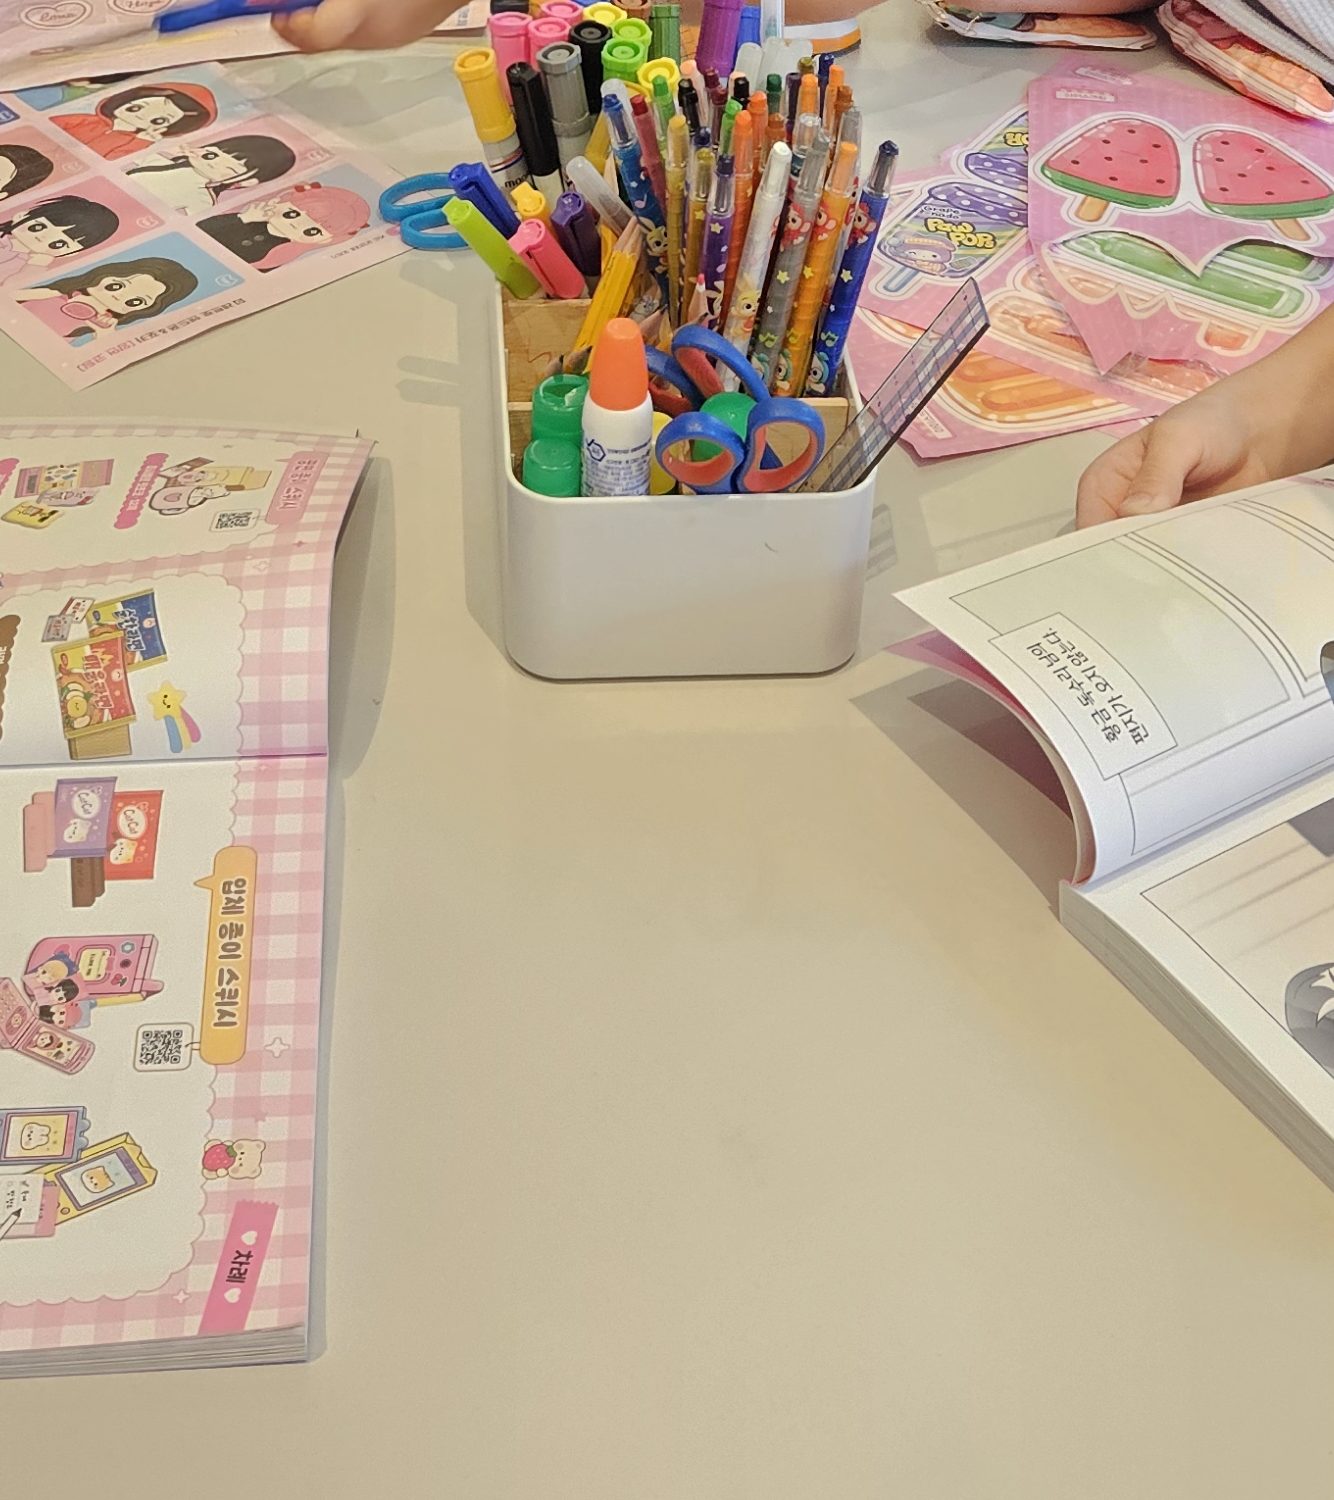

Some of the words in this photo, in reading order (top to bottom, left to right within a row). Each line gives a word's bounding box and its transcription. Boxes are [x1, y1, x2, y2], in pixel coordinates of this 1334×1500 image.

[923, 206, 960, 215] Grape
[277, 486, 307, 511] 스퀴시
[1027, 642, 1060, 668] 님의
[1043, 627, 1089, 668] 않는다.
[1053, 665, 1096, 707] 독수리
[1081, 665, 1114, 693] 오지
[1091, 708, 1121, 743] 황금
[1107, 694, 1149, 745] 편지가
[220, 877, 248, 916] 입체
[217, 921, 245, 961] 종이
[212, 967, 241, 1028] 스퀴시
[225, 1249, 255, 1284] 차례
